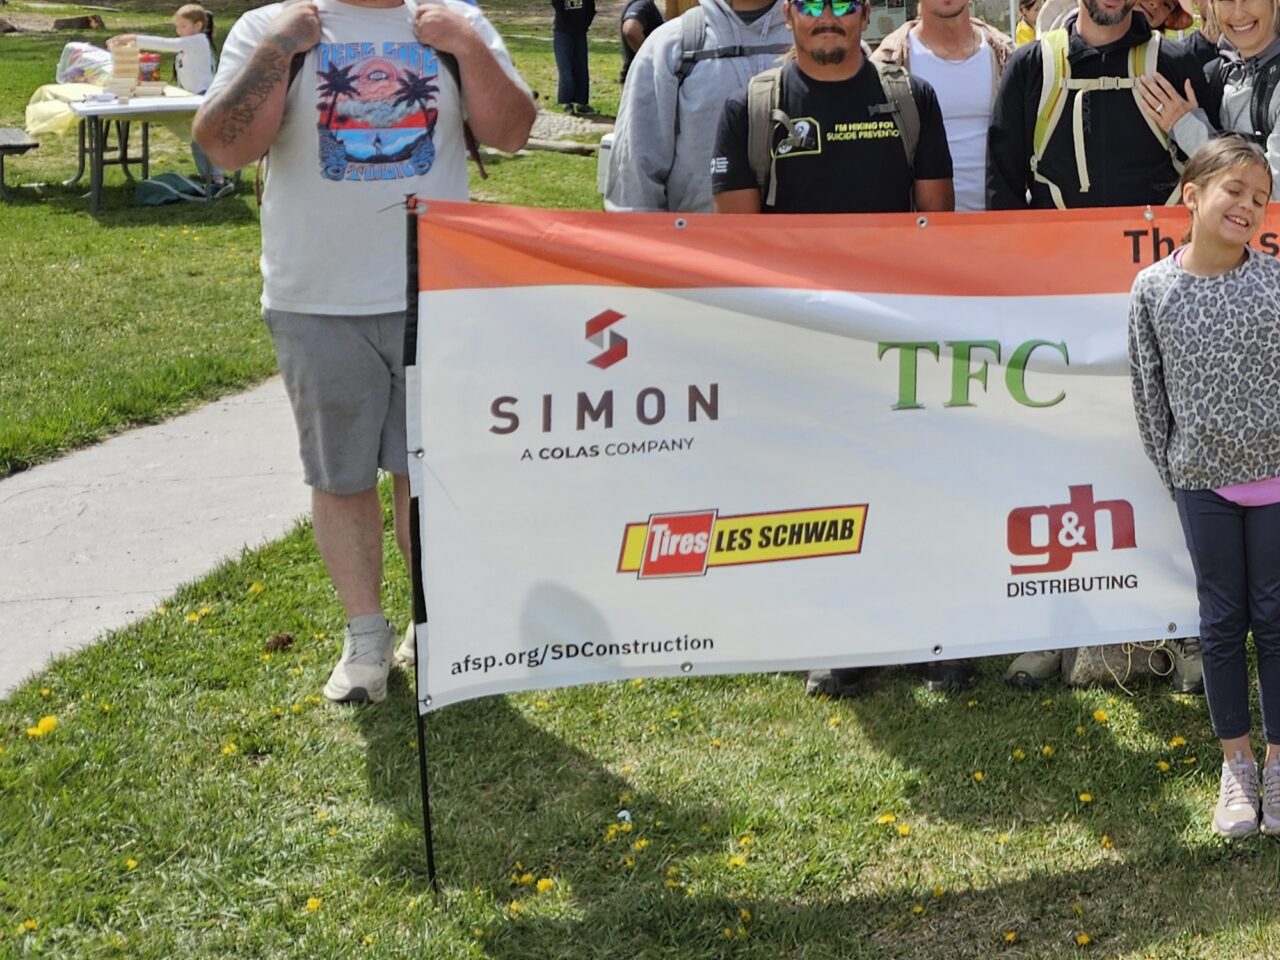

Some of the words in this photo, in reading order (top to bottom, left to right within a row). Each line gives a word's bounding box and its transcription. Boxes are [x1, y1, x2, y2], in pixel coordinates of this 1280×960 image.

[826, 130, 857, 141] SUICIDE
[858, 128, 900, 140] PREVENTIO
[848, 121, 877, 131] HIKING
[1124, 227, 1280, 264] Ths
[877, 338, 1070, 411] TFC
[489, 382, 719, 436] SIMON
[520, 448, 533, 461] A
[538, 444, 600, 460] COLAS
[605, 436, 696, 457] COMPANY
[649, 523, 709, 563] Tires
[714, 527, 753, 554] LES
[757, 518, 855, 549] SCHWAB
[1007, 483, 1138, 575] g&h
[1007, 574, 1138, 599] DISTRIBUTING
[450, 634, 715, 676] afsp.org/SDConstruction
